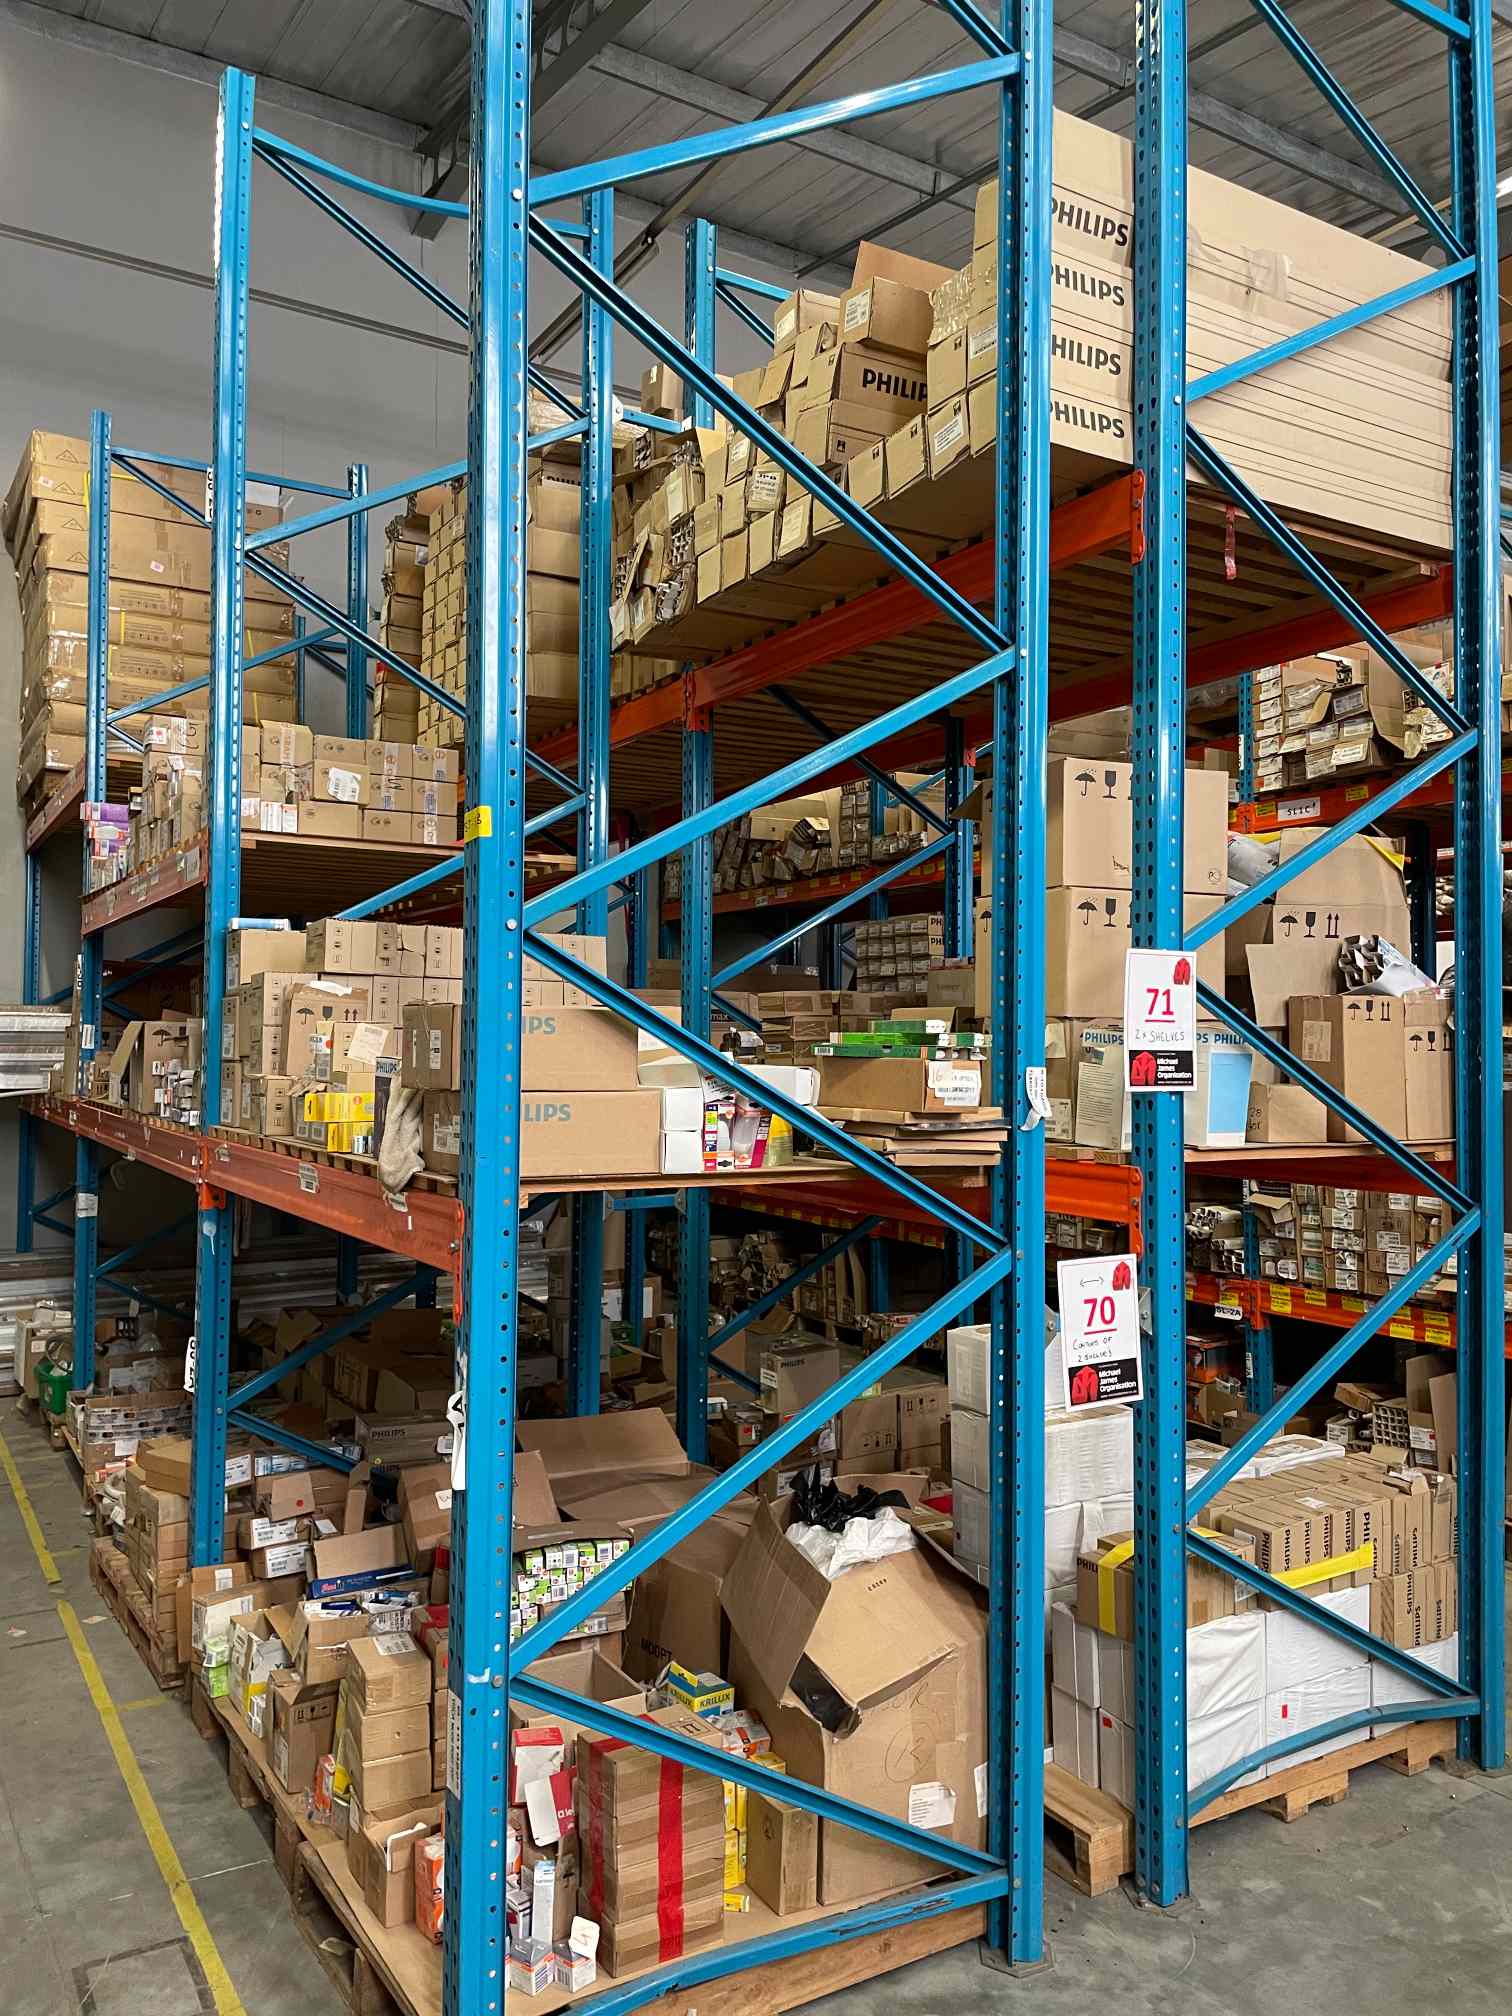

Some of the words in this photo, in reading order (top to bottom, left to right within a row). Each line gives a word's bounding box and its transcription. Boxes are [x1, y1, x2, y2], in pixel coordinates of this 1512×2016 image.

[1050, 264, 1125, 306] HILIPS
[1049, 400, 1125, 438] HILIPS
[1146, 988, 1174, 1016] 71
[1084, 1032, 1124, 1045] PHILIPS
[1148, 1031, 1185, 1043] SHELVES
[1083, 1296, 1116, 1327] 70
[1099, 1368, 1121, 1377] Michael
[1099, 1376, 1118, 1385] James
[1099, 1381, 1137, 1393] Organisation
